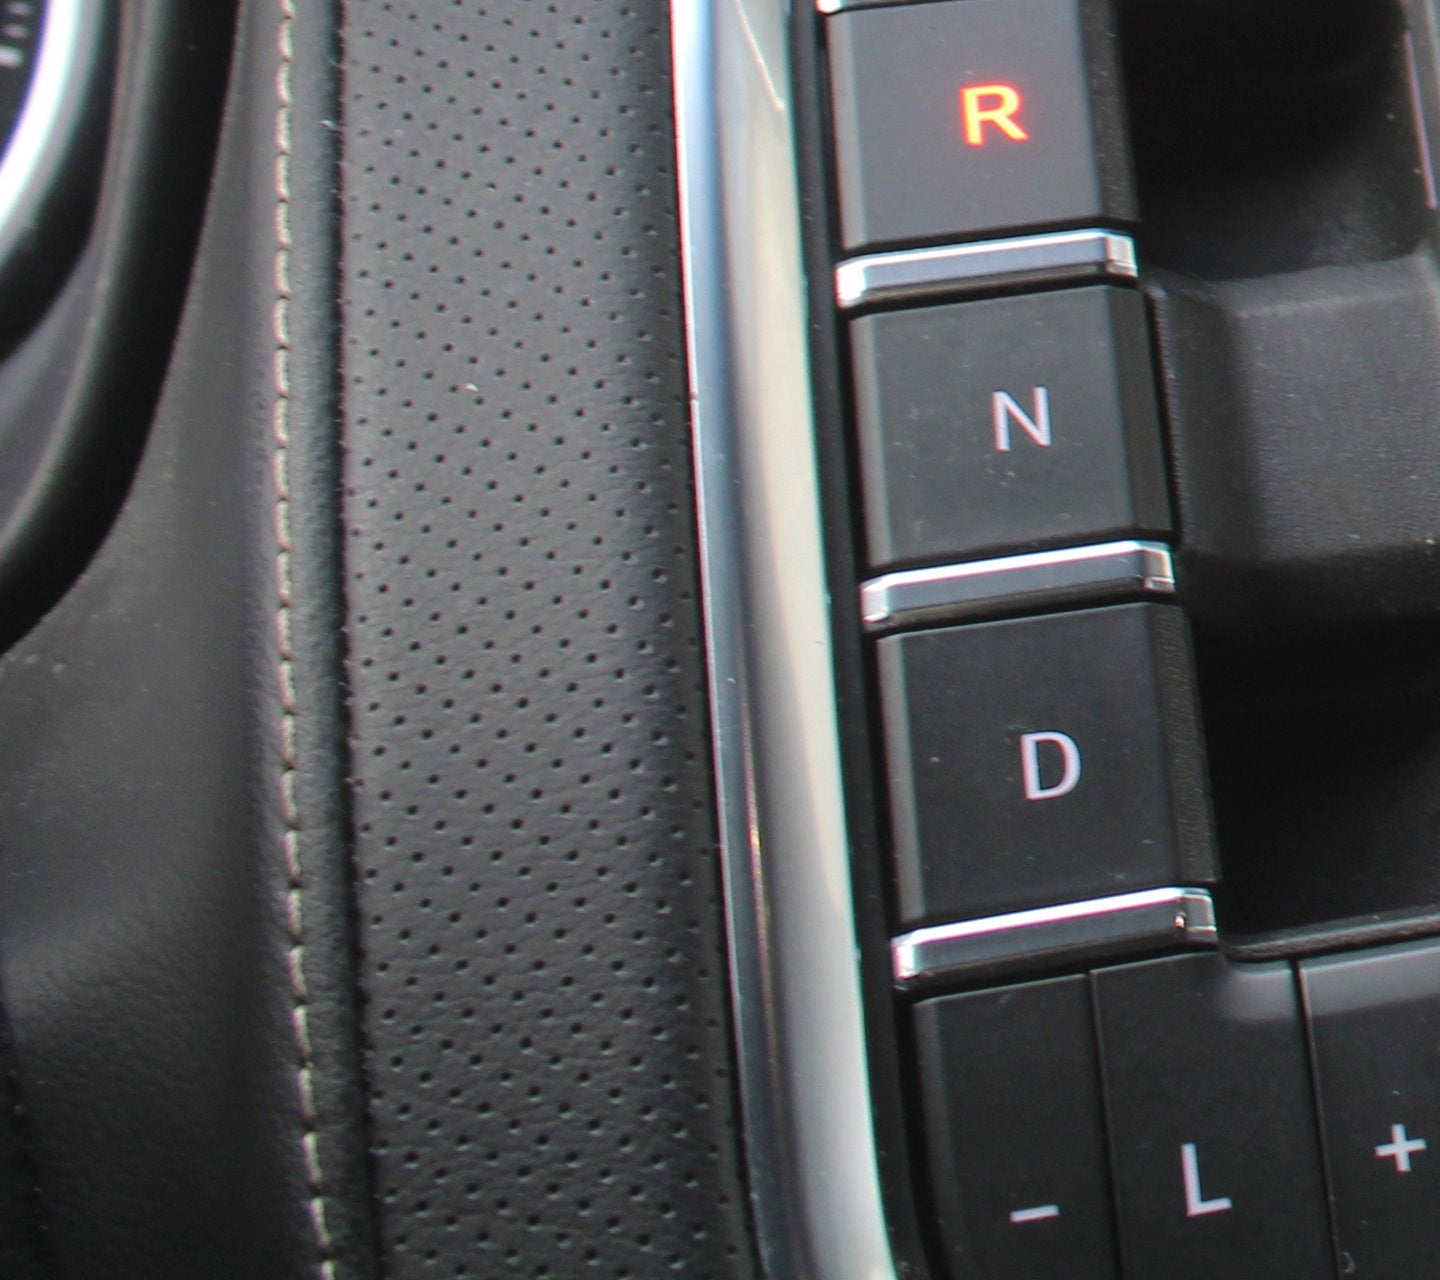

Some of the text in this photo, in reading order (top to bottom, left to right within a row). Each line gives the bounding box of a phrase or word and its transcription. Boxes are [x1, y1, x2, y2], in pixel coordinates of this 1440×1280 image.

[958, 80, 1031, 148] R
[992, 386, 1051, 451] N
[1020, 731, 1081, 801] D
[1181, 1143, 1232, 1217] L
